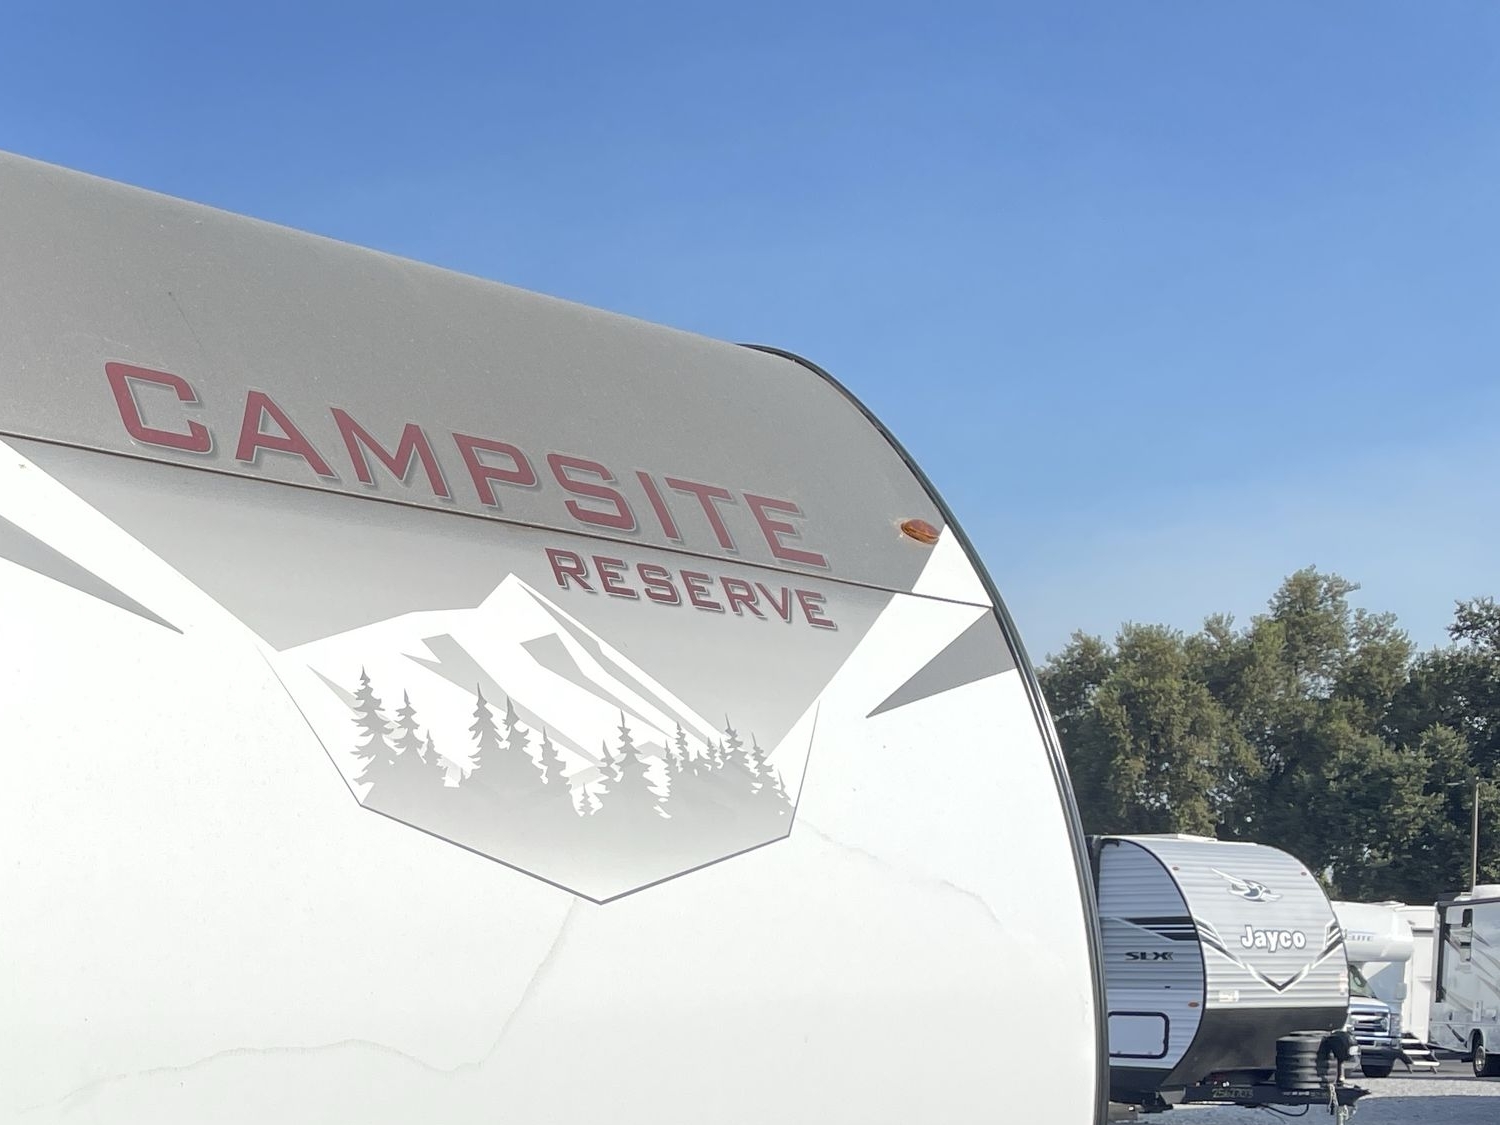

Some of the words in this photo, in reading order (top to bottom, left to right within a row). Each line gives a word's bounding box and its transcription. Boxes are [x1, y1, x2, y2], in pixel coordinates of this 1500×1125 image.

[104, 361, 828, 570] CAMPSITE
[544, 546, 838, 631] RESERVE
[1241, 925, 1306, 952] Jayco
